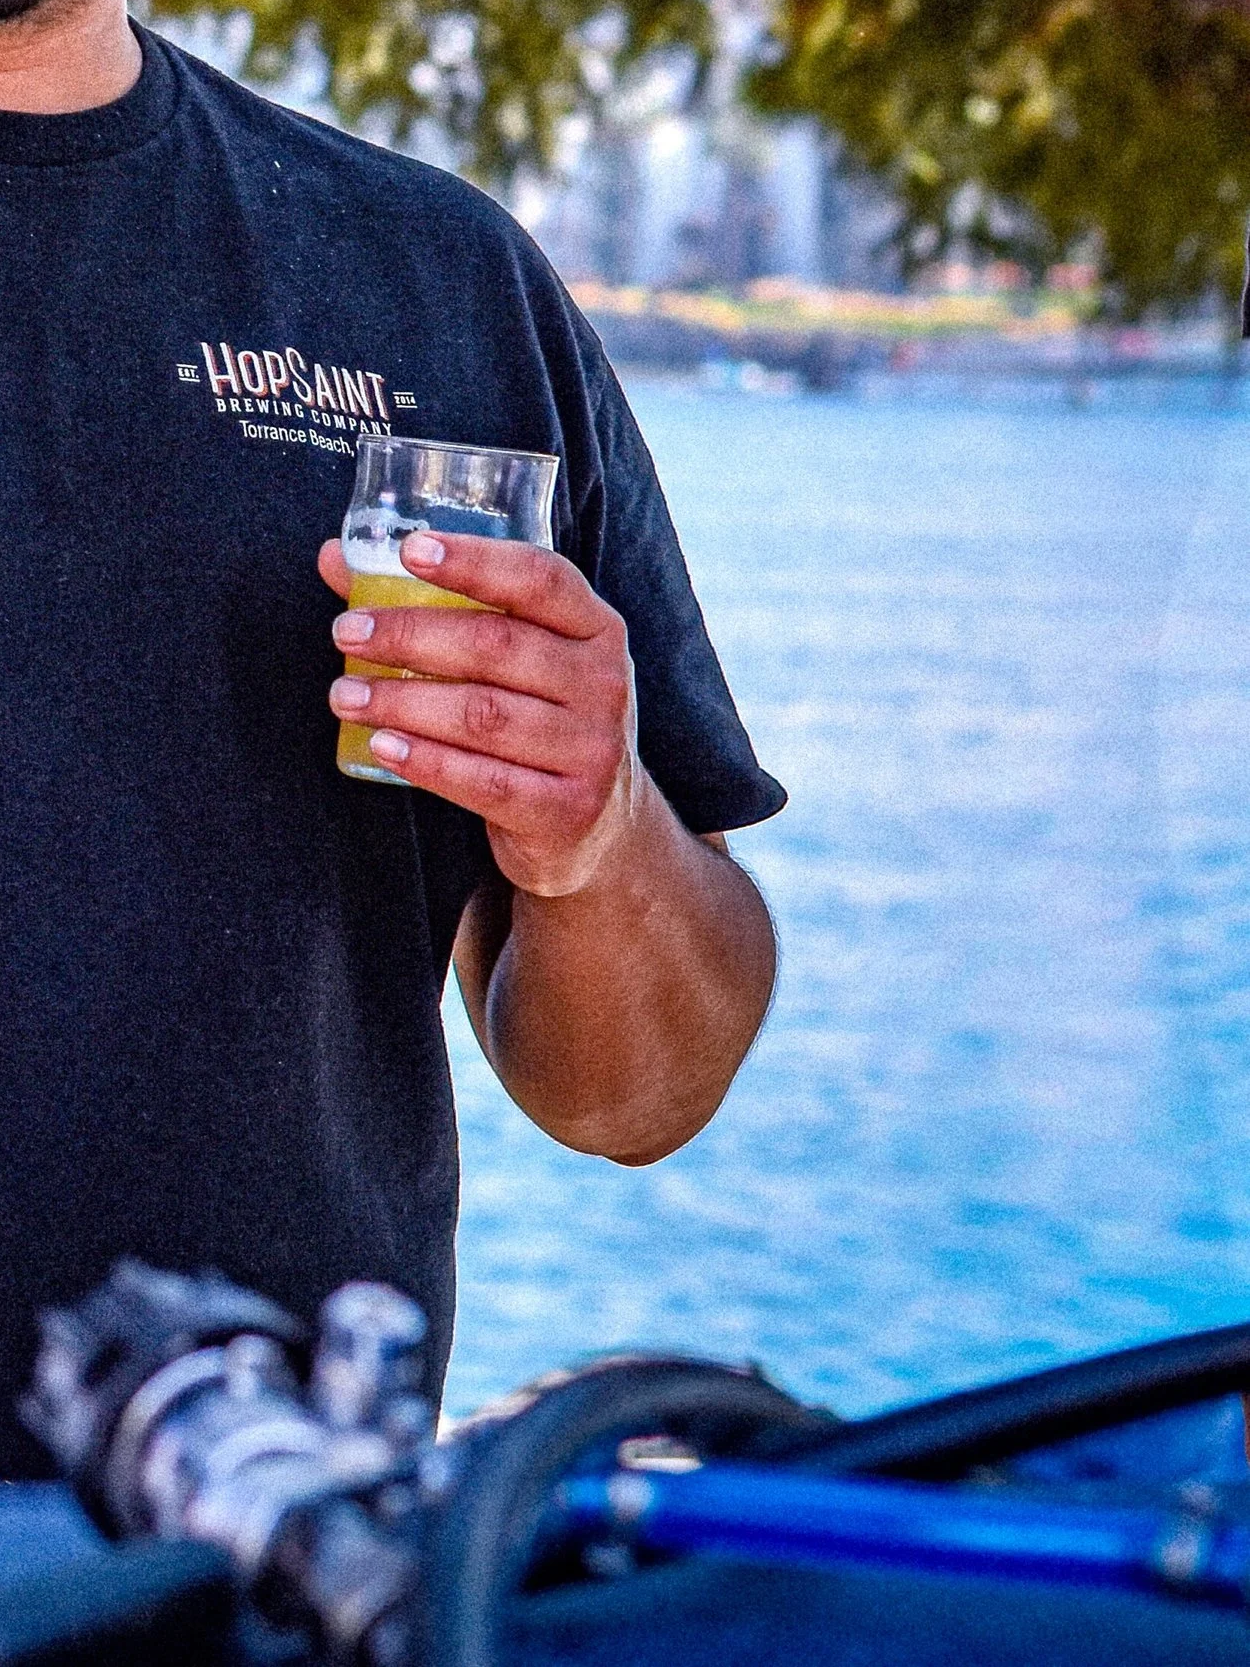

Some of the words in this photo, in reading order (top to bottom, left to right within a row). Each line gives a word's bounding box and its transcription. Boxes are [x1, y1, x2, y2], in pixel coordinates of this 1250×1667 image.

[215, 398, 304, 419] BREWING
[311, 409, 392, 436] COMPANY
[395, 395, 417, 405] 2014
[239, 420, 307, 443] Torrance
[309, 429, 355, 457] Beach,
